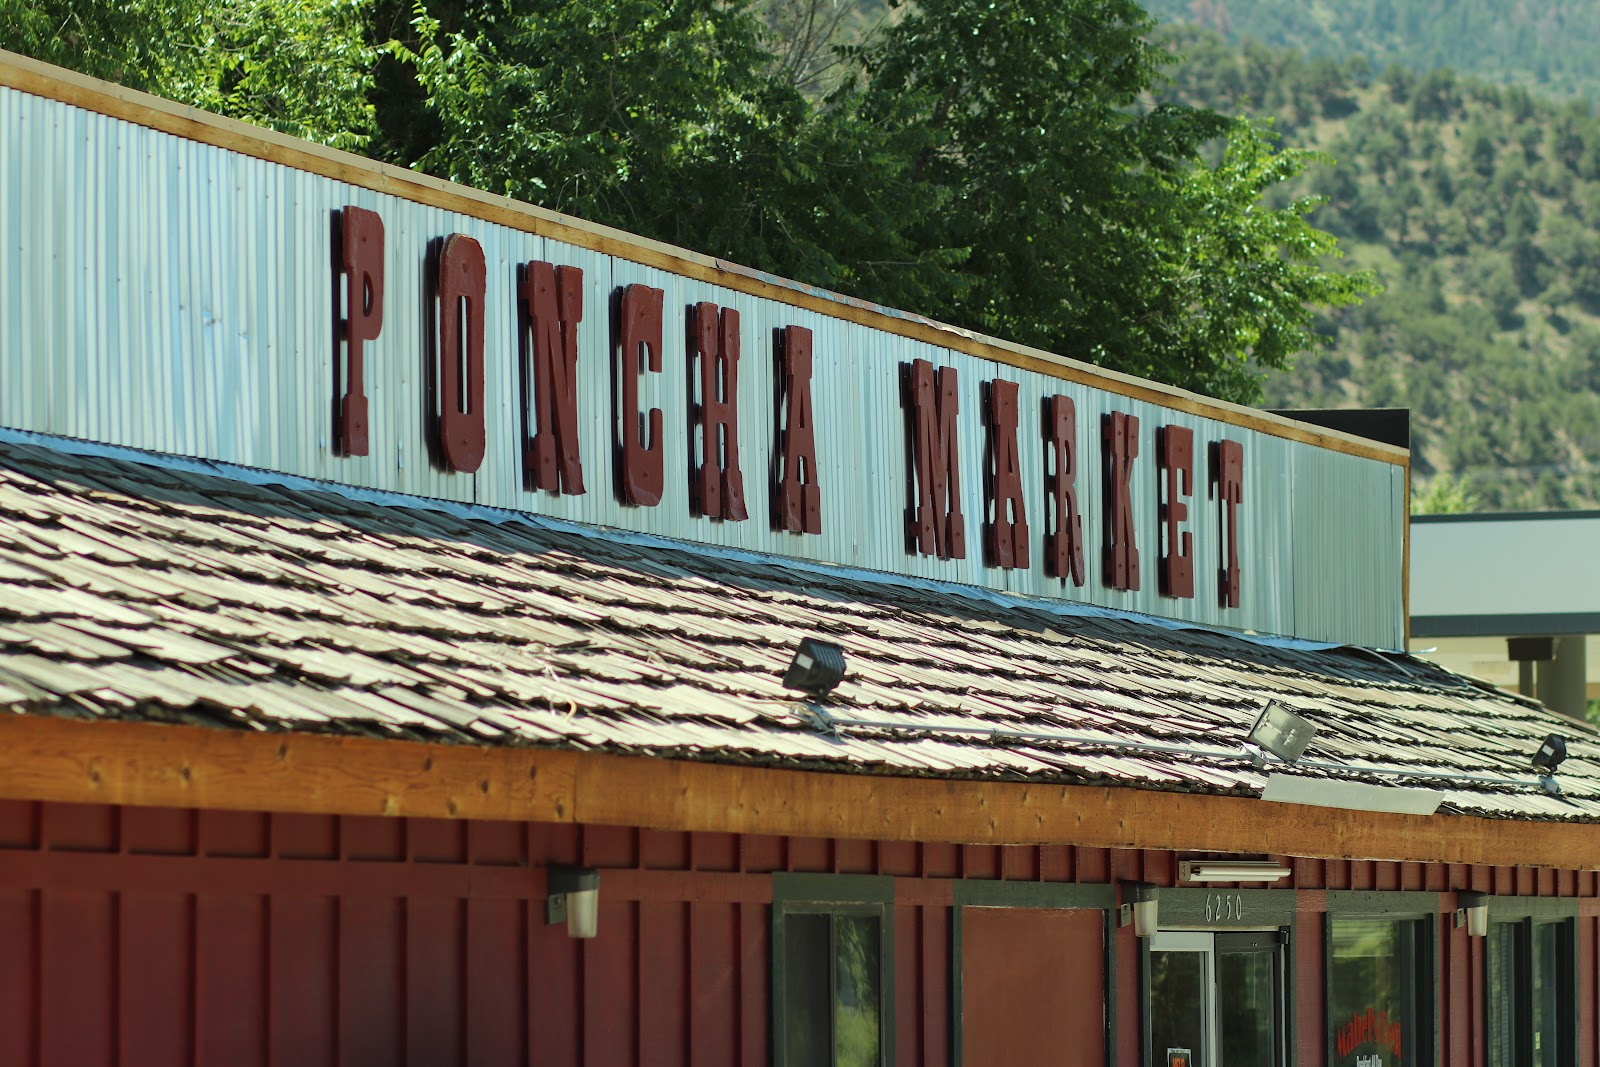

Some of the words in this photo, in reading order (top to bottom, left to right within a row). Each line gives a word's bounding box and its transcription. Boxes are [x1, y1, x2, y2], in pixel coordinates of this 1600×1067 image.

[342, 205, 822, 535] PONCHA
[912, 358, 1244, 608] MARKET
[1205, 893, 1242, 922] 6250
